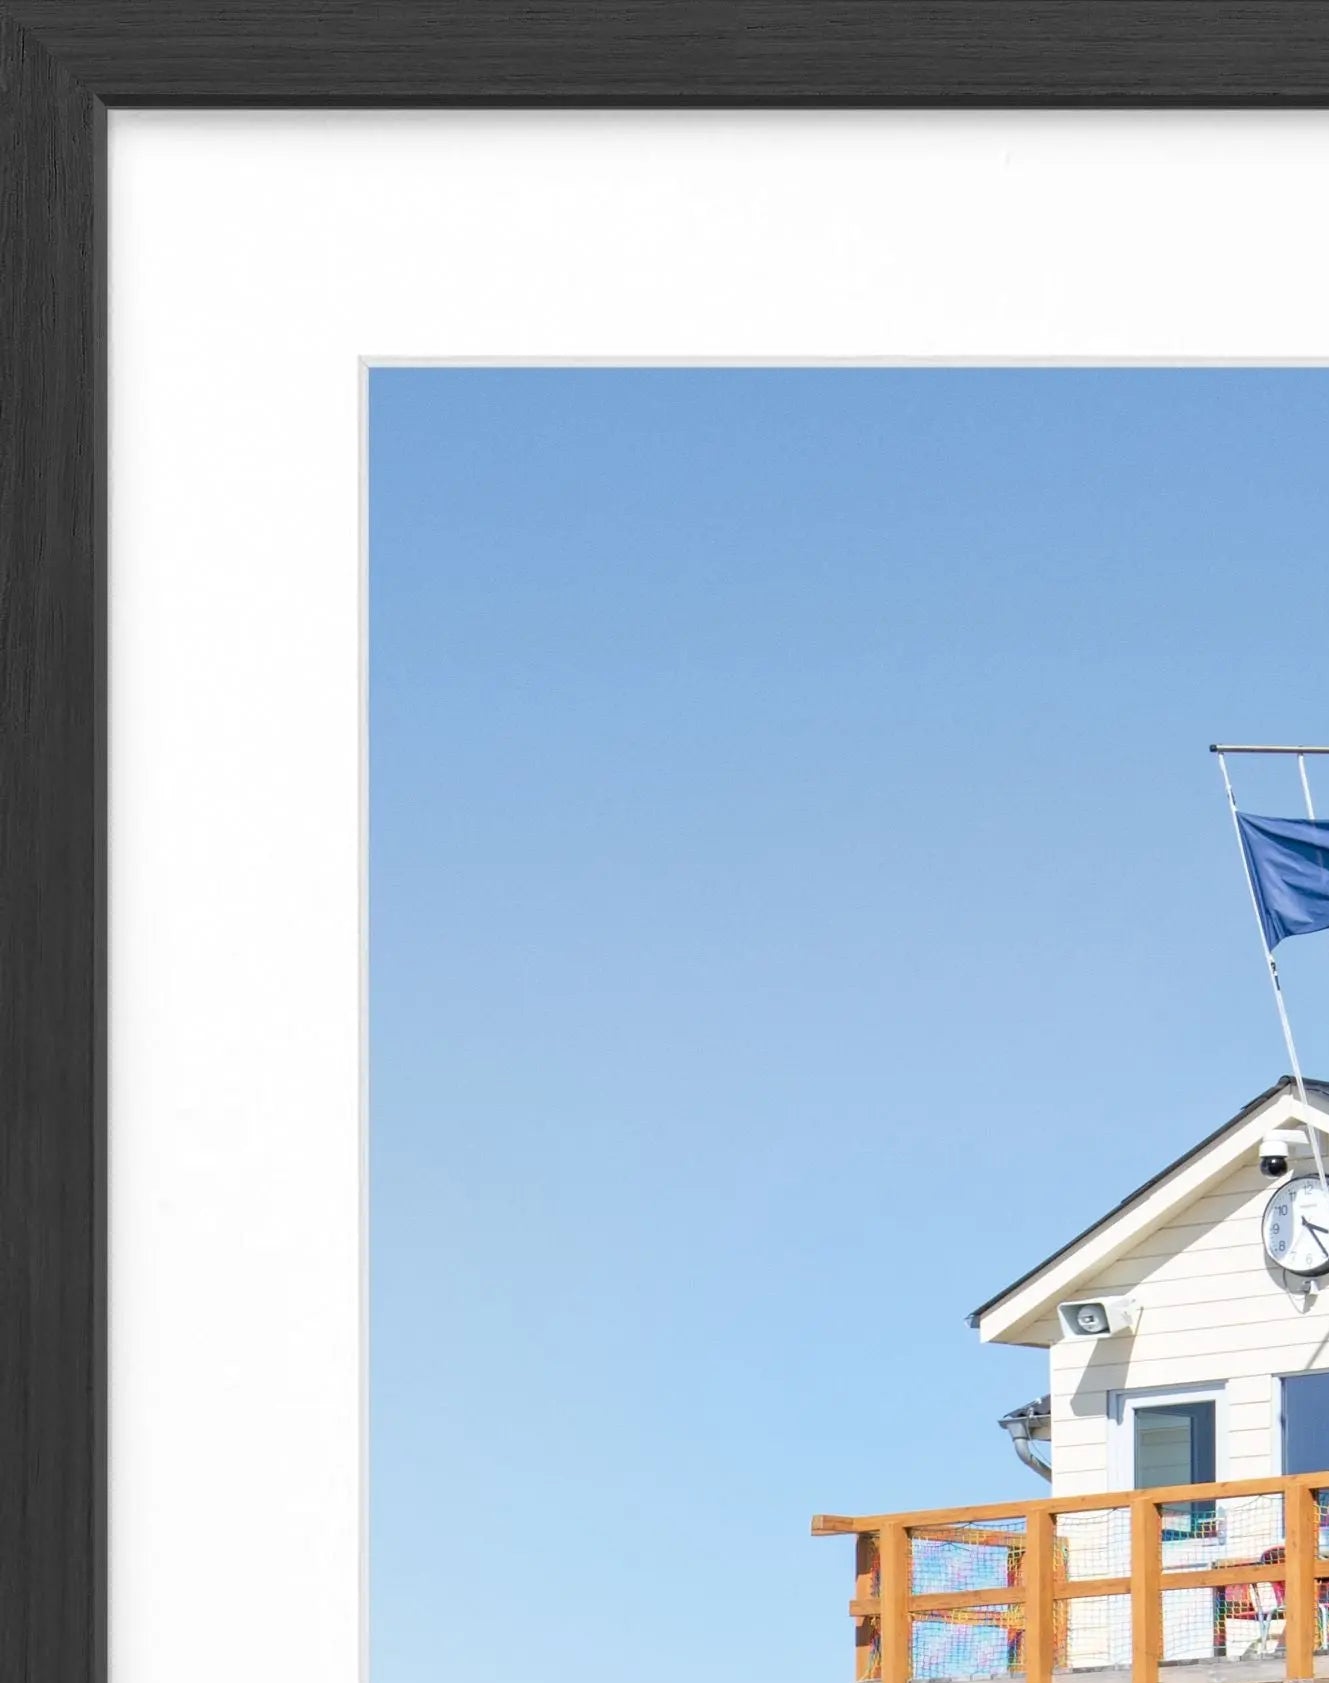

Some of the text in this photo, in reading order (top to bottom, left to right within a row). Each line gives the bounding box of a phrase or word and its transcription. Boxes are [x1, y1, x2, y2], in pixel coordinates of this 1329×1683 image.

[1303, 1184, 1313, 1195] 12
[1276, 1204, 1288, 1216] 10
[1272, 1223, 1280, 1234] 9
[1279, 1240, 1286, 1251] 8
